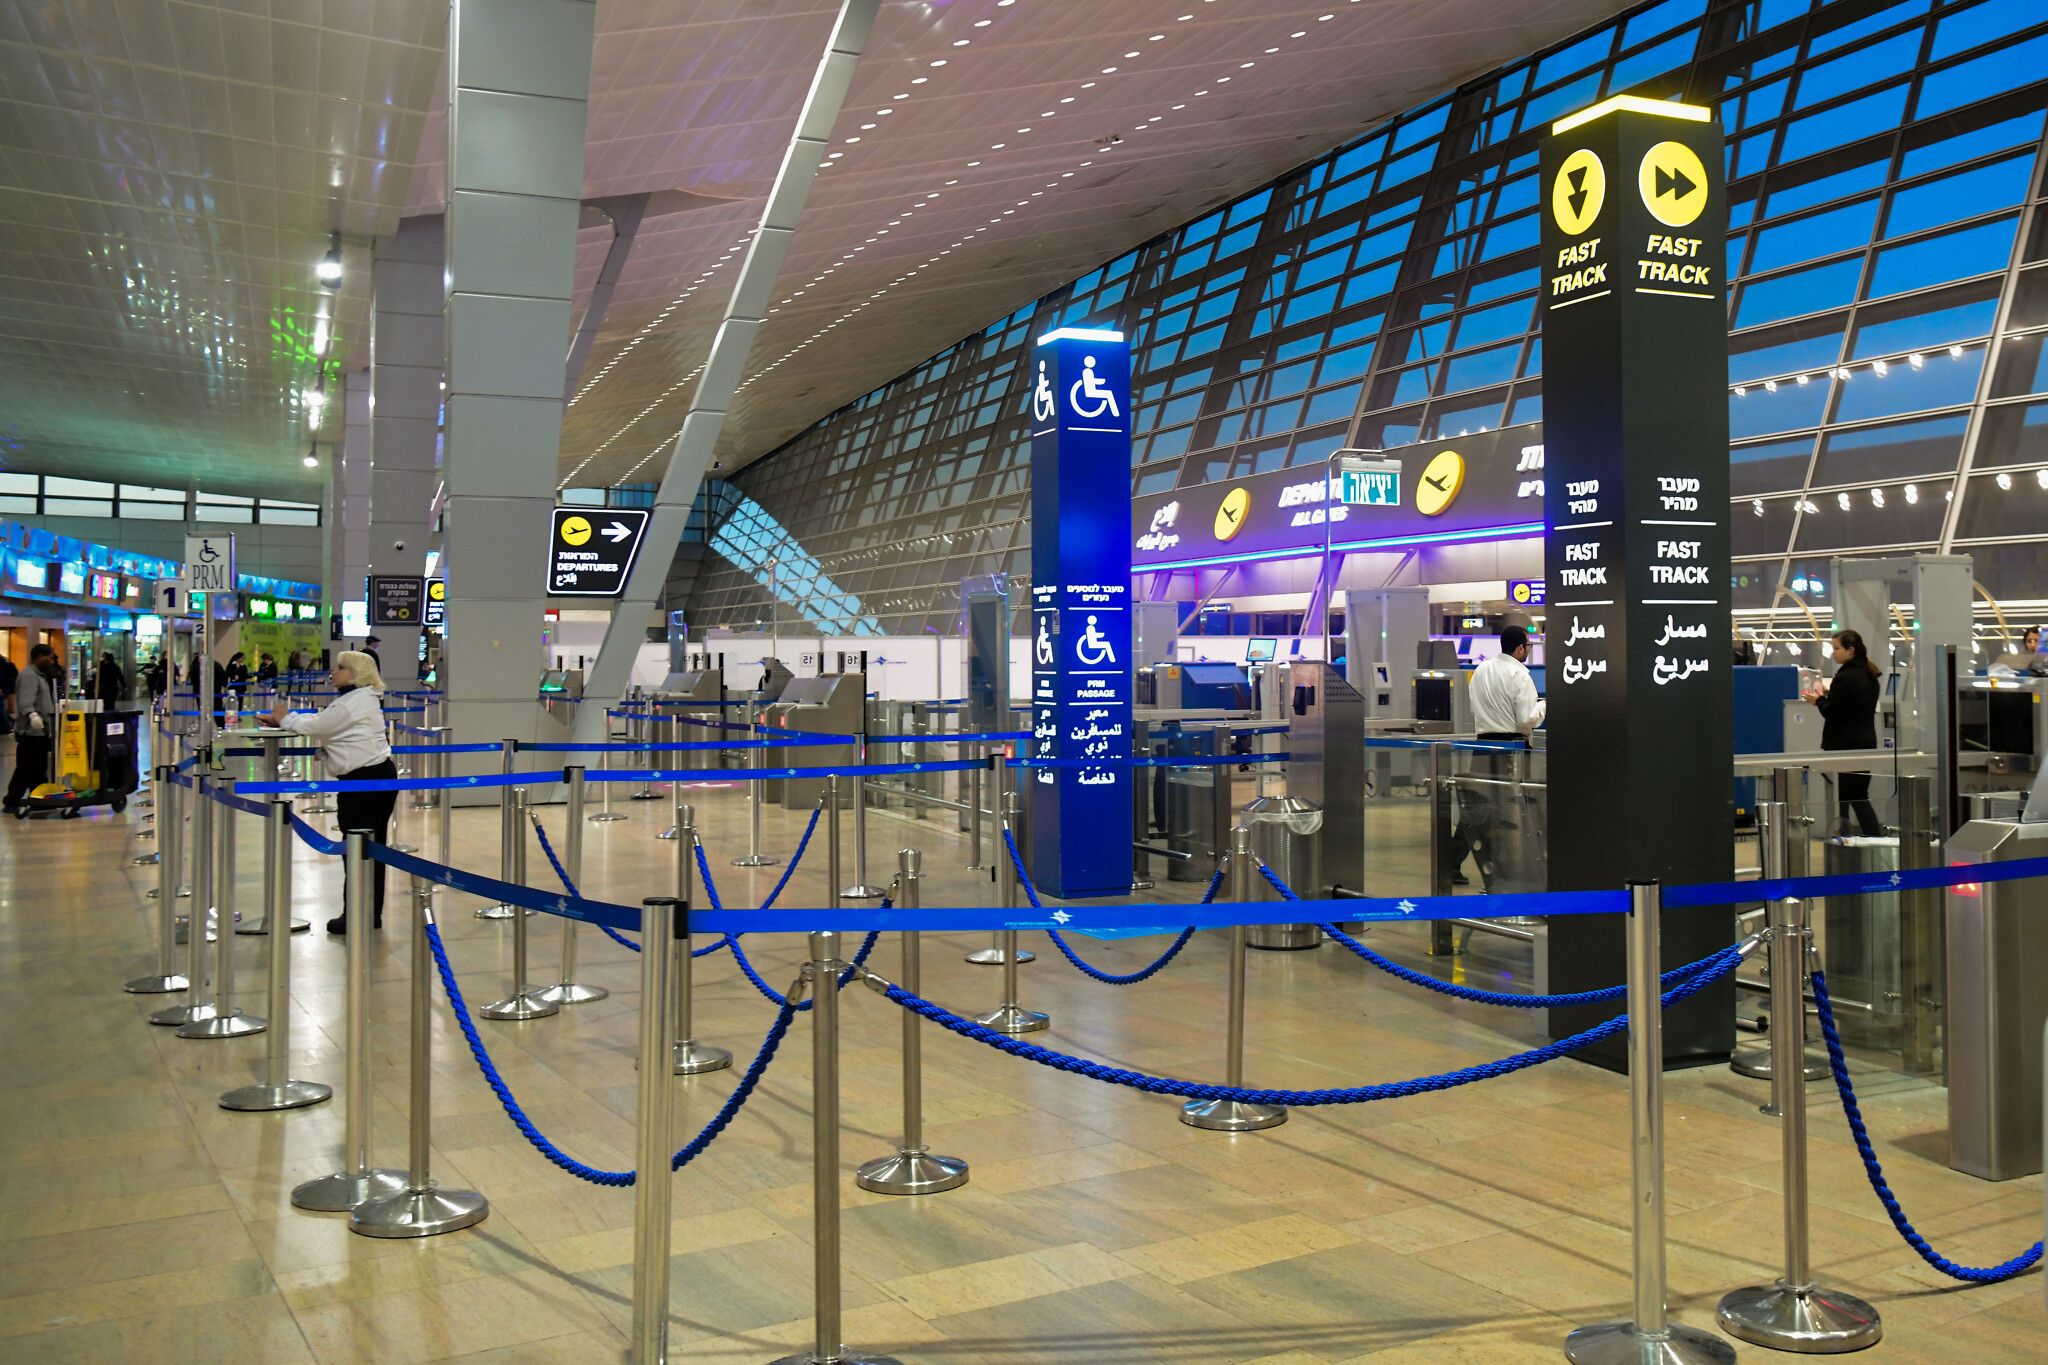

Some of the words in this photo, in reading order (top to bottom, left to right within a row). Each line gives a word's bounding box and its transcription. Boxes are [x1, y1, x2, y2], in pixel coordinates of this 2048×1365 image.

[1557, 238, 1601, 268] FAST
[1646, 234, 1702, 257] FAST
[1552, 263, 1607, 296] TRACK
[1637, 260, 1711, 285] TRACK
[1350, 473, 1391, 504] יציאה
[1566, 480, 1599, 496] מעבר
[1657, 477, 1700, 493] מעבר
[1568, 498, 1597, 514] מהיר
[1660, 496, 1698, 511] מהיר
[1291, 511, 1312, 526] ALL
[1565, 542, 1600, 561] FAST
[1657, 540, 1701, 558] FAST
[192, 564, 224, 589] PRM
[556, 563, 618, 572] DEPARTURES
[1560, 567, 1607, 586] TRACK
[1649, 566, 1709, 584] TRACK
[163, 587, 176, 608] 1
[195, 624, 204, 633] 2
[1564, 615, 1605, 646] مسار
[1654, 615, 1707, 646] مسار
[1563, 655, 1607, 684] سريع
[1653, 655, 1709, 685] سريع
[1087, 680, 1106, 688] PRM
[1077, 690, 1116, 698] PASSAGE
